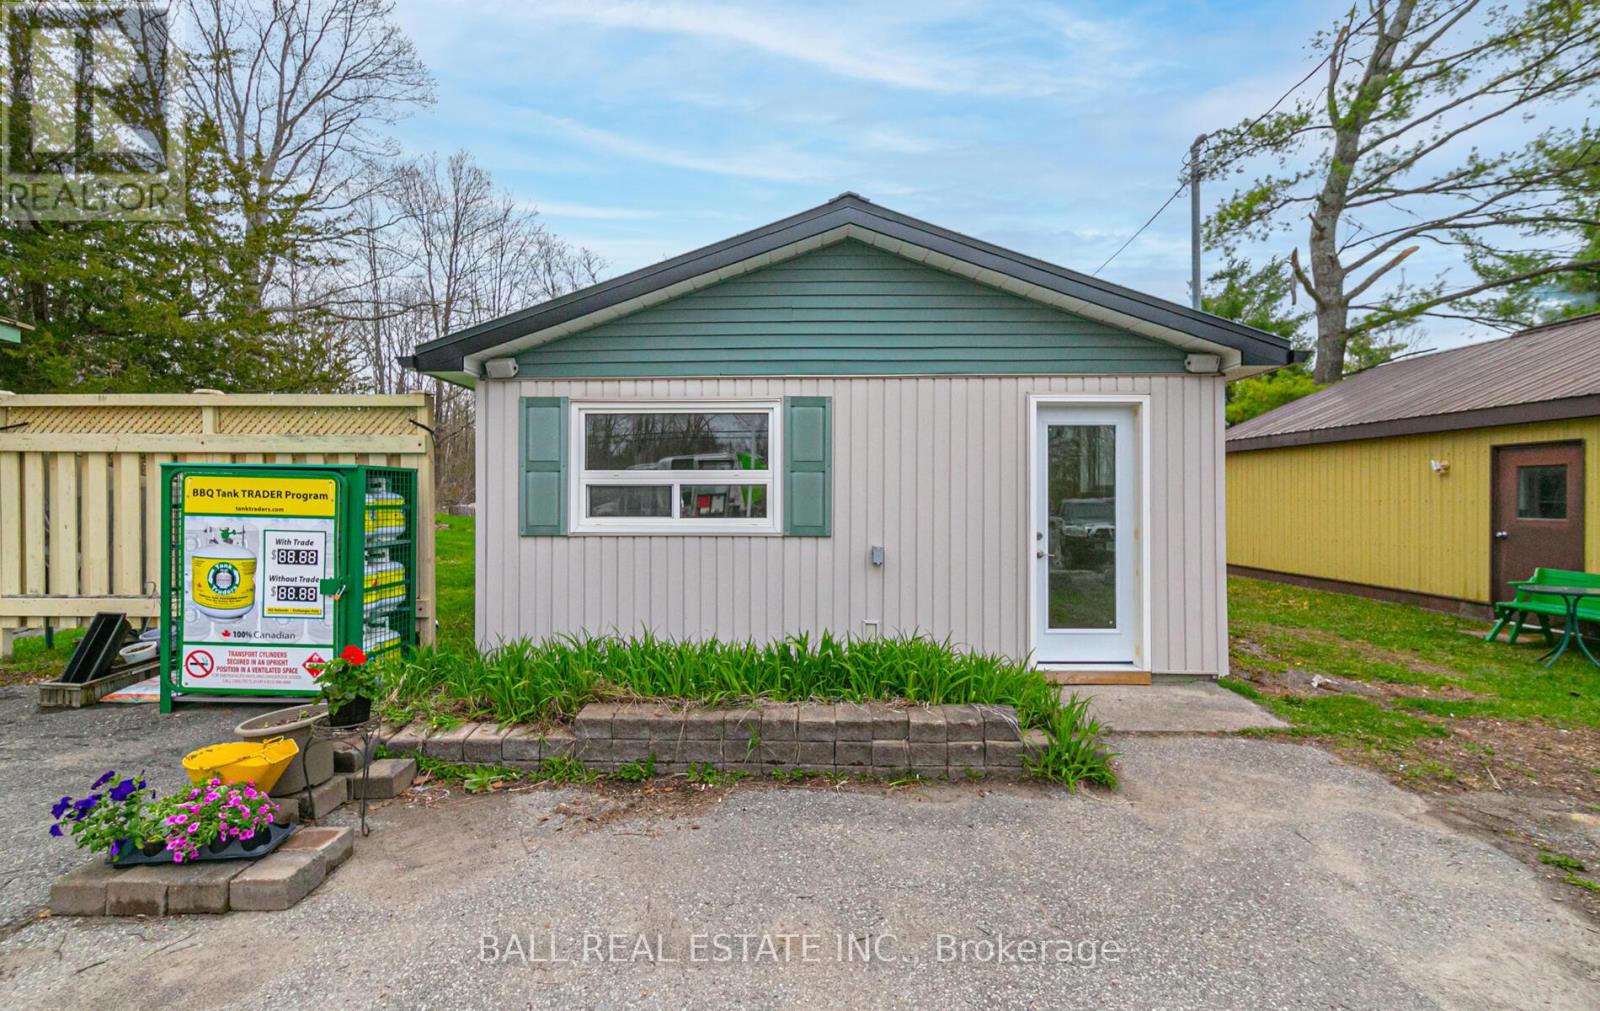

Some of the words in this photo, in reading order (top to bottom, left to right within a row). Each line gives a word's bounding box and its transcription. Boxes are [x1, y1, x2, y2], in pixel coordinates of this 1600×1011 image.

[192, 488, 214, 498] BBQ
[215, 488, 239, 498] Tank
[241, 489, 283, 499] TRADER
[285, 490, 328, 501] Program
[269, 575, 298, 583] Without
[232, 630, 252, 639] 100%
[253, 631, 295, 640] Canadian
